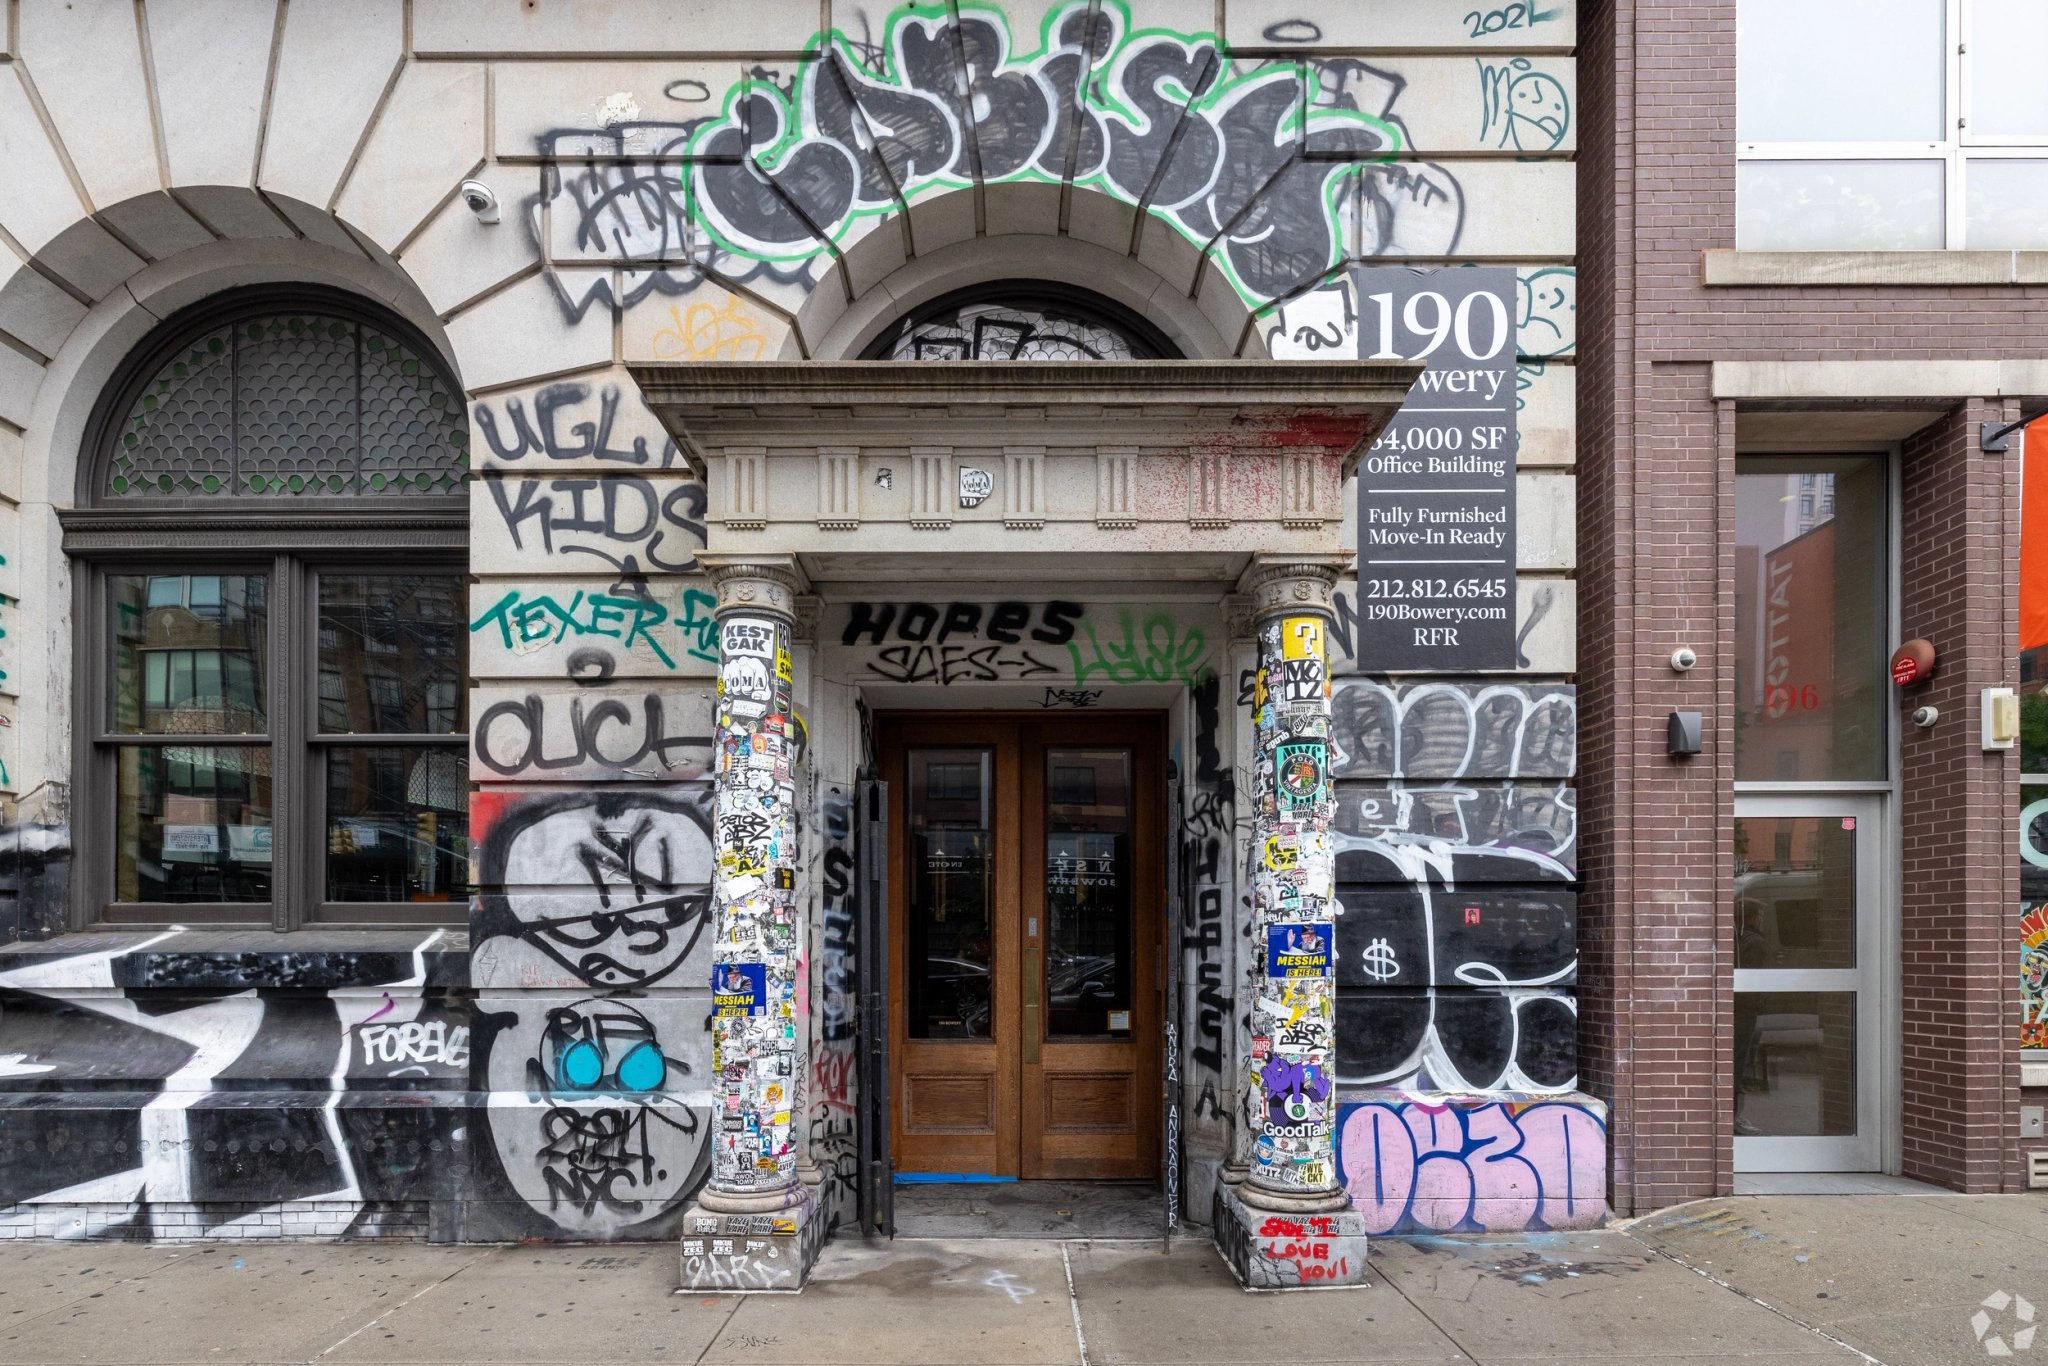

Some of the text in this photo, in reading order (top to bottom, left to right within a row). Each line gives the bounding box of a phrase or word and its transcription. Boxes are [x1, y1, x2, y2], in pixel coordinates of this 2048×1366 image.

[1368, 290, 1508, 360] 190
[1408, 368, 1507, 401] wery
[1471, 426, 1507, 450] SF
[1367, 455, 1506, 477] Office Building
[482, 460, 707, 572] KIDS
[1368, 506, 1507, 527] Fully Furnished
[1368, 527, 1506, 548] Move-In Ready
[1367, 578, 1507, 598] 212.812.6545
[841, 600, 1085, 646] HOPES
[1367, 604, 1507, 623] 190Bowery.com
[725, 624, 774, 641] KEST
[1413, 627, 1459, 646] RFR
[726, 637, 766, 653] GAK
[724, 675, 765, 689] COMA
[1291, 756, 1314, 766] POLO
[1296, 908, 1316, 918] YES
[1276, 955, 1327, 966] MESSIAH
[1286, 968, 1322, 977] IS HERE!
[714, 994, 755, 1006] MESSIAH
[724, 1007, 748, 1017] HERE!
[1263, 1121, 1330, 1138] GoodTalk
[1265, 1241, 1329, 1260] LOVE
